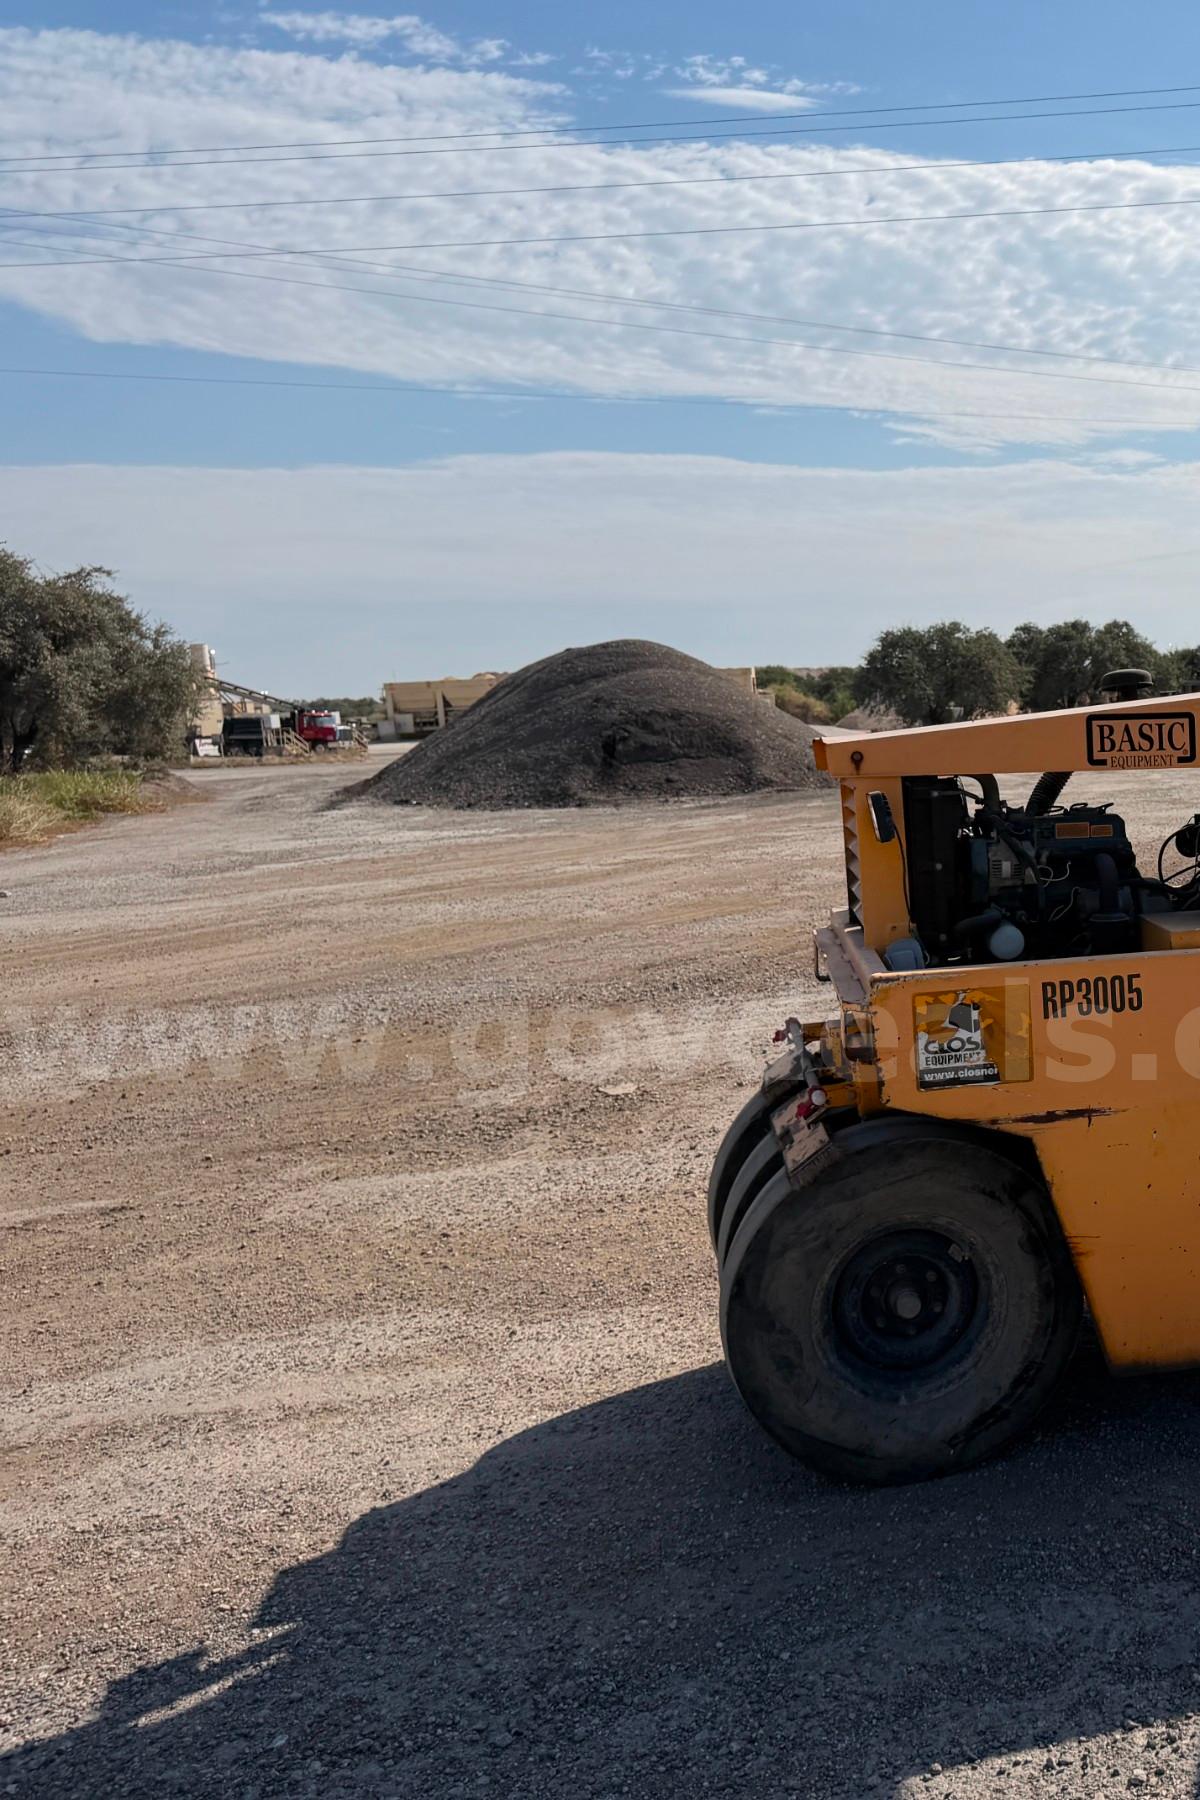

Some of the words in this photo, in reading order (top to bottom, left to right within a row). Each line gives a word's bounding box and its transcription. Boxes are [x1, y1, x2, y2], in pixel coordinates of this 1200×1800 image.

[1097, 721, 1186, 753] BASIC
[1110, 754, 1175, 769] EQUIPMENT
[1042, 974, 1143, 1019] RP3005
